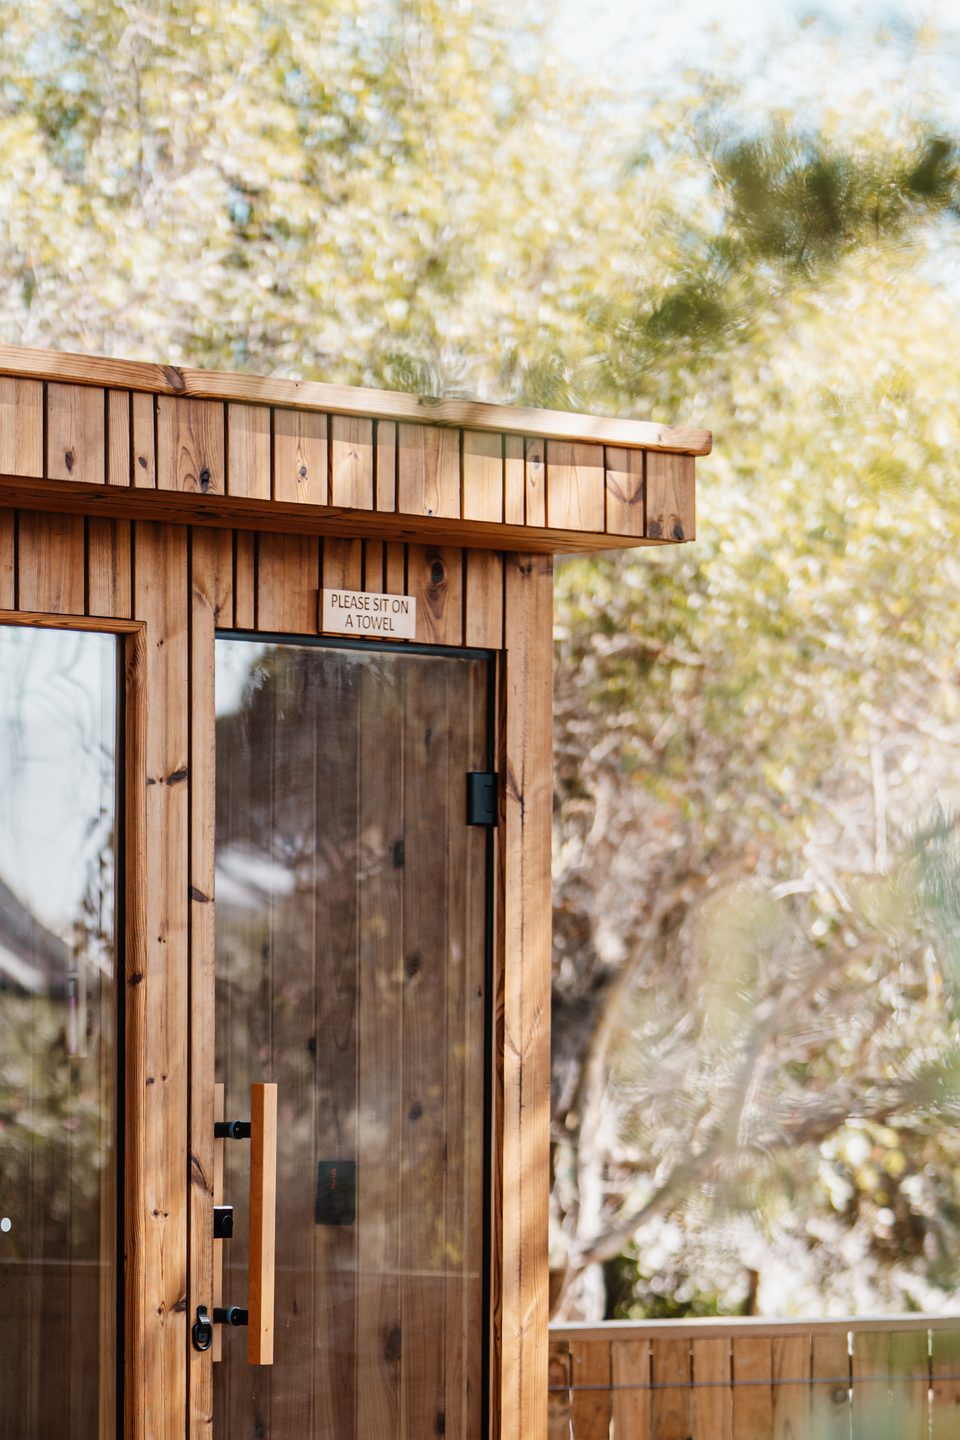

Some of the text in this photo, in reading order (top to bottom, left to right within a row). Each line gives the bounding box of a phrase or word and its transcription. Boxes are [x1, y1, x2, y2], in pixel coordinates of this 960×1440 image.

[331, 594, 409, 614] PLEASE SIT ON
[345, 614, 395, 631] A TOWEL
